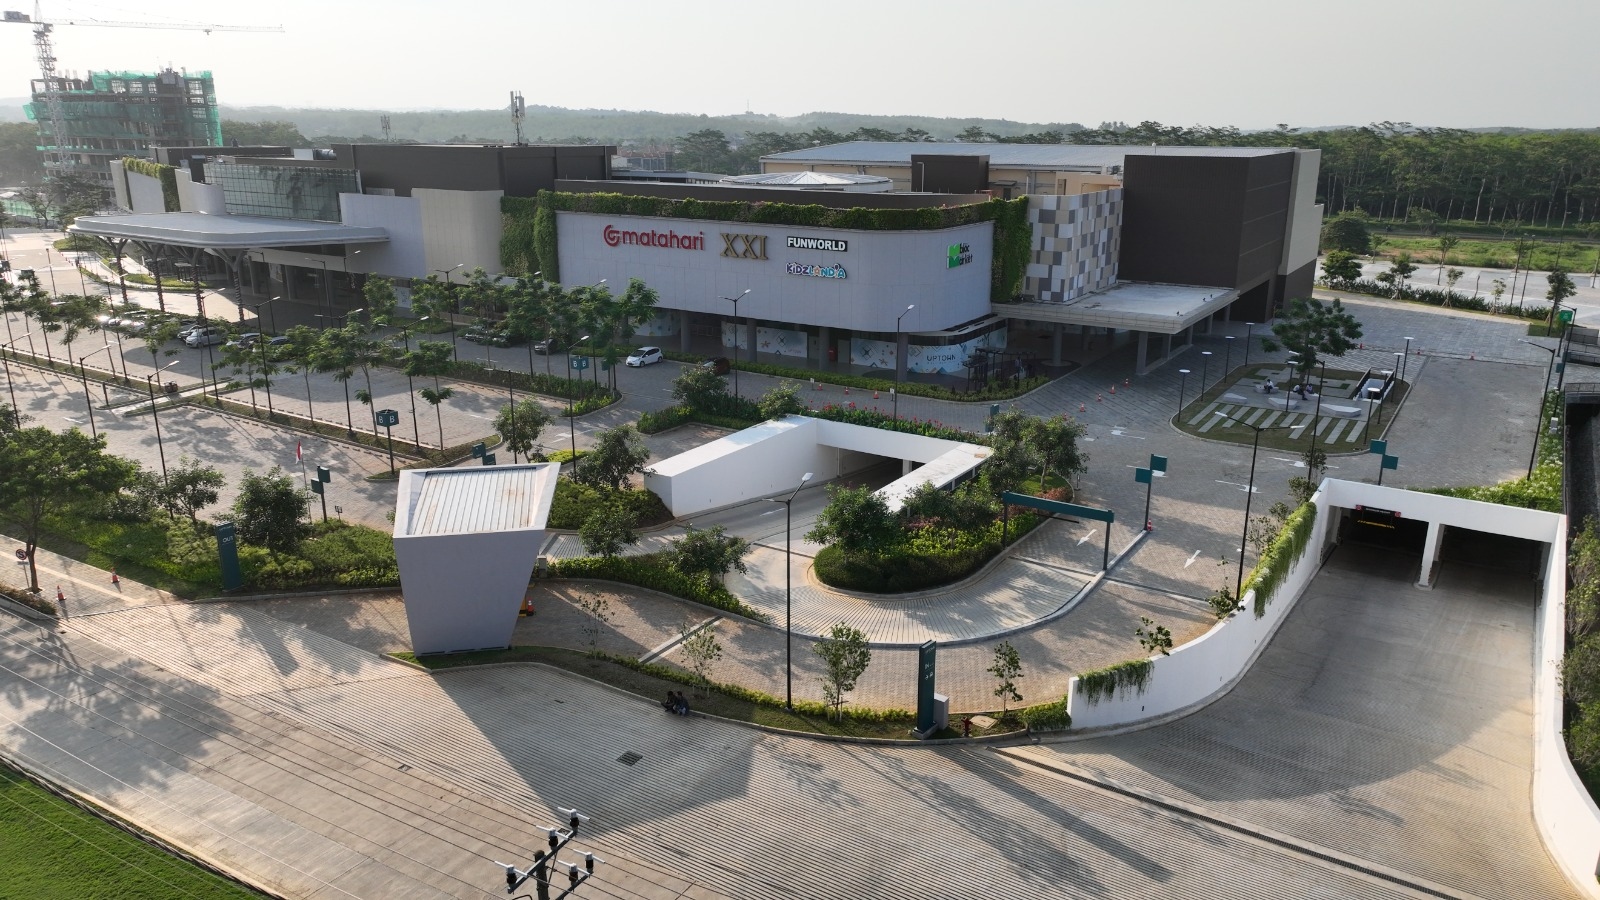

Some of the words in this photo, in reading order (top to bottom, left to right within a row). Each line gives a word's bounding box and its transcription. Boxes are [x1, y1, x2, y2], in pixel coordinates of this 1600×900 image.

[622, 230, 705, 250] matahari
[720, 232, 769, 260] XXI
[787, 237, 846, 251] FUNWORLD
[926, 354, 956, 362] UPTOWN
[389, 415, 395, 423] B
